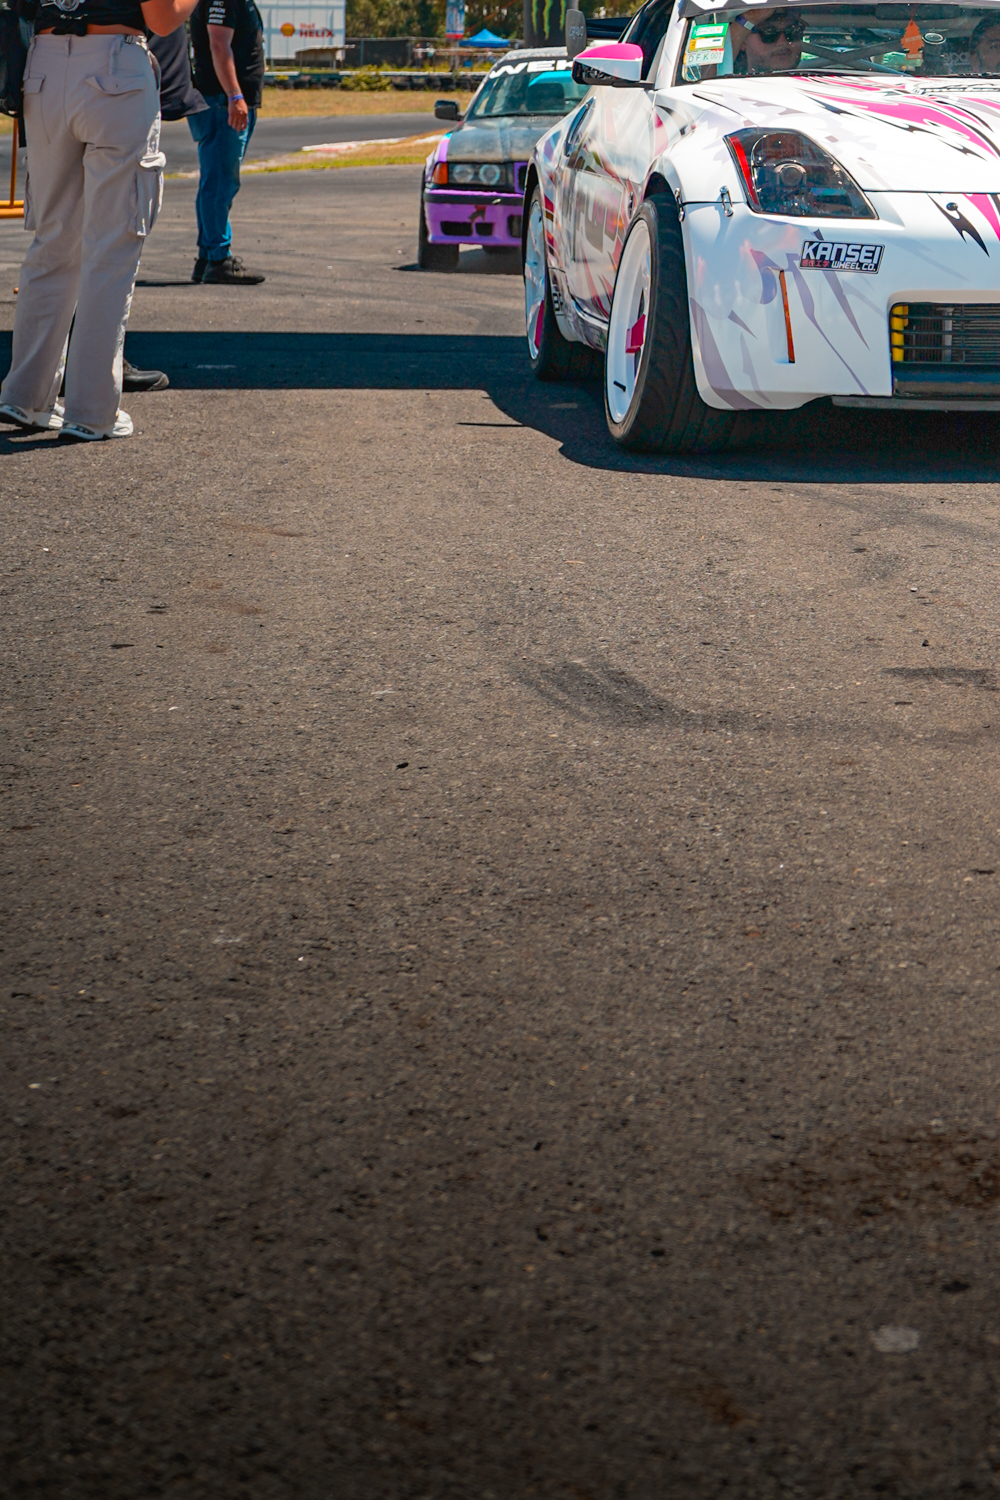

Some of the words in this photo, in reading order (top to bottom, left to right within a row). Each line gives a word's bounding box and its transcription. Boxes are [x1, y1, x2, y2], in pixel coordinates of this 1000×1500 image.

[299, 29, 334, 37] HELIX
[802, 242, 882, 264] KANSEI
[831, 260, 861, 270] WHEEL
